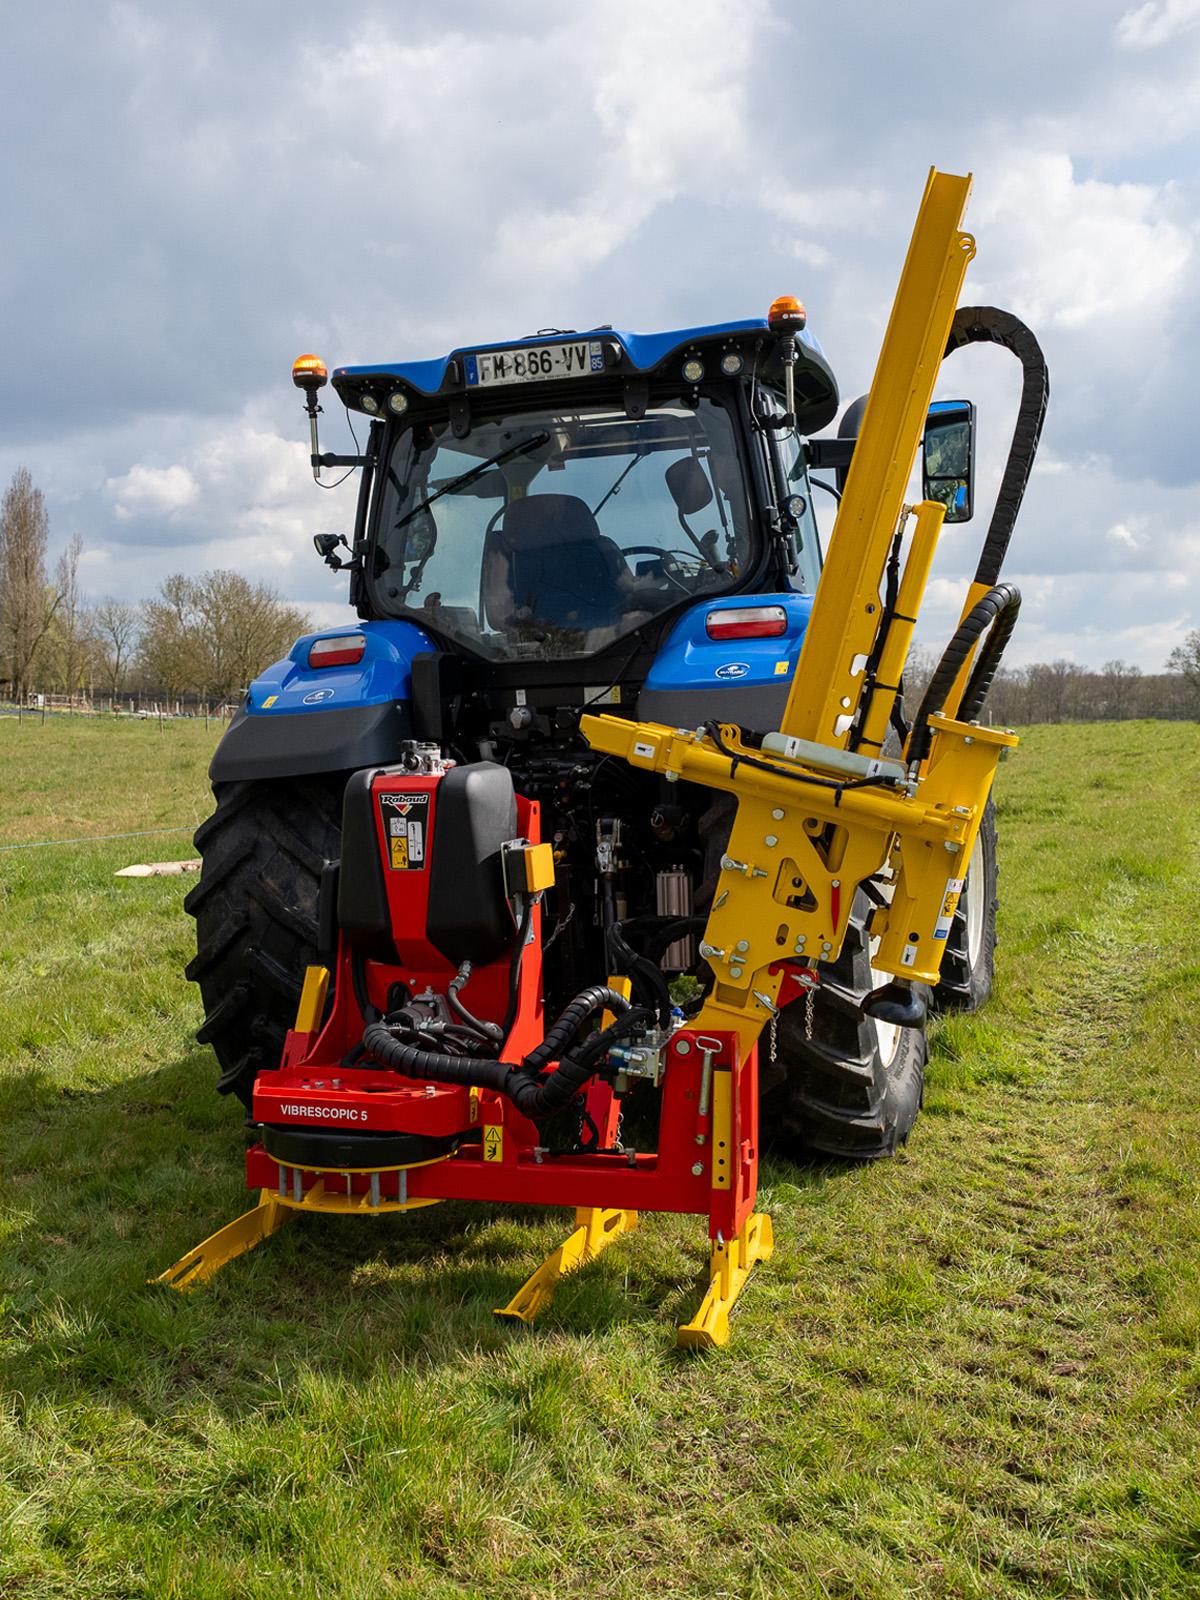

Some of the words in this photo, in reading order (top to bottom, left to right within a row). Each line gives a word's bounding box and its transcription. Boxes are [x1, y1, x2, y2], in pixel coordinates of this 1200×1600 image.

[480, 345, 586, 381] FM-866-VV
[591, 357, 603, 369] 85
[381, 795, 429, 806] Rabaud
[280, 1104, 358, 1121] VIBRESCOPIC
[361, 1110, 368, 1121] 5
